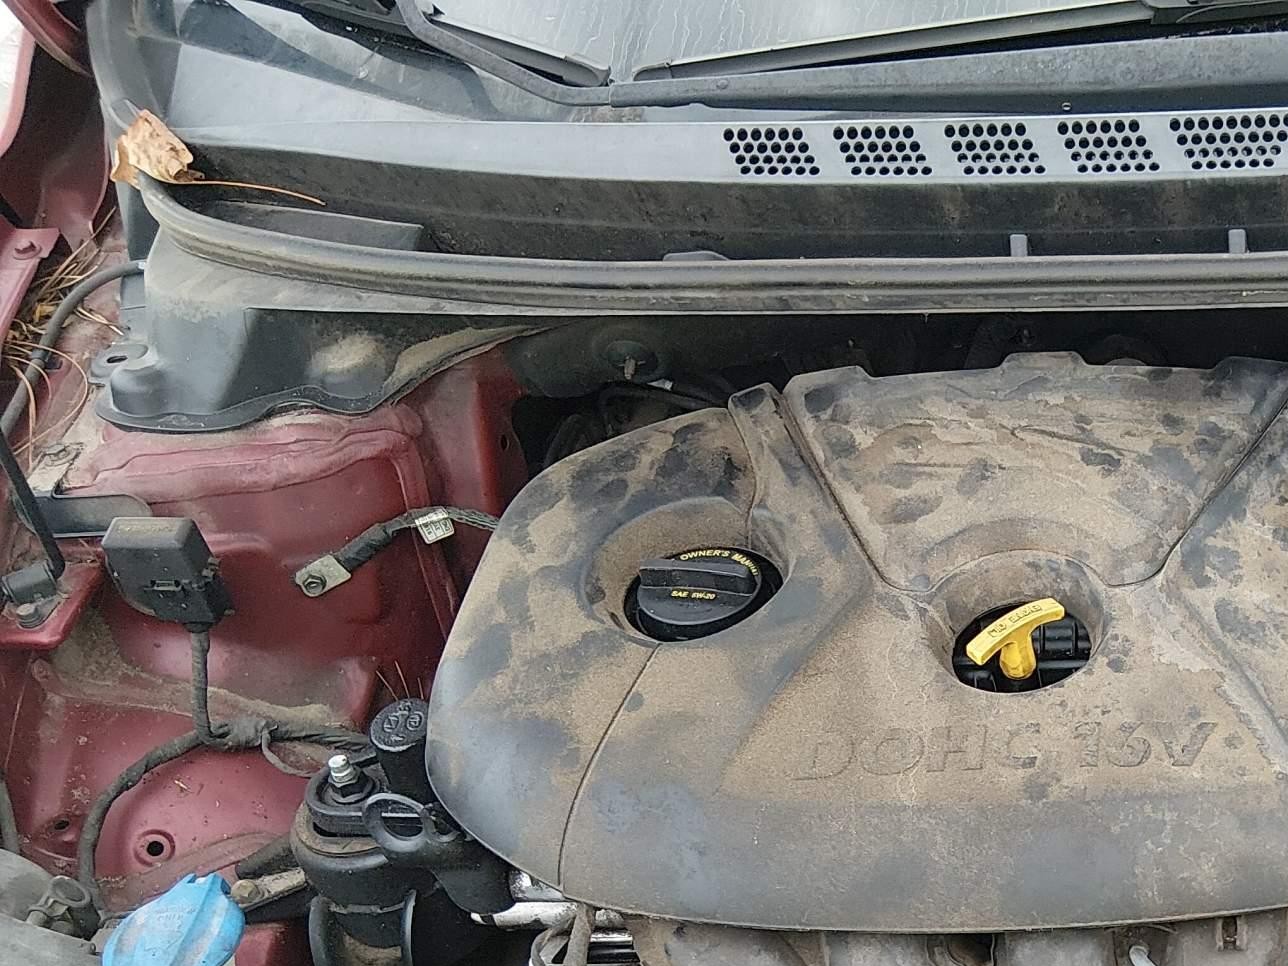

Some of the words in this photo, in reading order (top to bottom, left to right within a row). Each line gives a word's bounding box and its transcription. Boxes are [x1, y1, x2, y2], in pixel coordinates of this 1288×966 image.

[679, 549, 731, 560] OWNER'S
[670, 590, 690, 598] SAE
[785, 721, 1042, 781] DOHC
[1072, 721, 1218, 768] 16V
